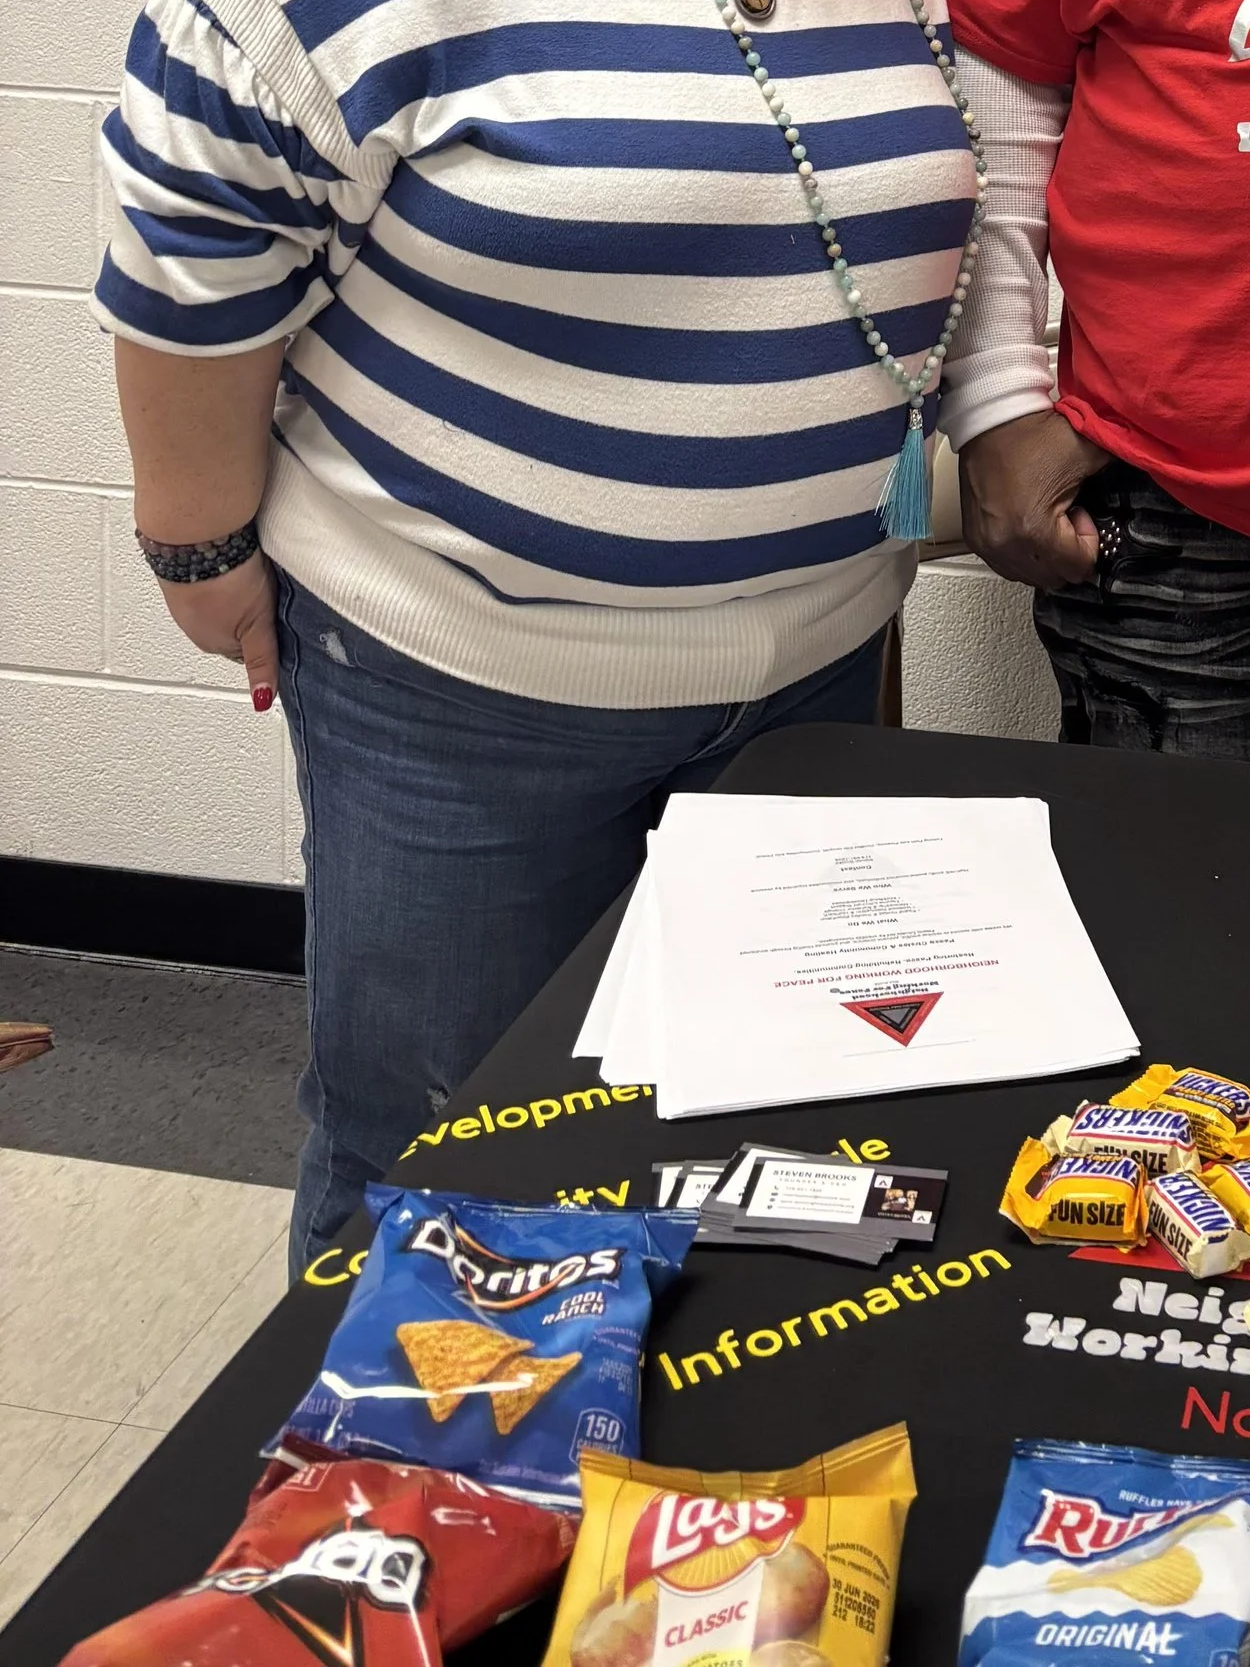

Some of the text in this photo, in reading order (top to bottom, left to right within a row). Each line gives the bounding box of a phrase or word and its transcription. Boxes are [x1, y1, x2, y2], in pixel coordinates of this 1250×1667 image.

[774, 960, 1000, 988] NEIGHBORHOOD WORKING FOR PEACE
[772, 1169, 857, 1182] STEVEN BROOKS
[1048, 1198, 1127, 1226] FUN SIZE
[1150, 1201, 1194, 1261] FUN SIZE
[409, 1218, 620, 1295] Doritos
[542, 1301, 605, 1326] RANCH
[559, 1290, 604, 1312] COOL
[658, 1248, 1012, 1391] Information
[586, 1414, 621, 1443] 150
[1119, 1489, 1164, 1507] RUFFLES
[844, 1583, 861, 1599] JUN
[665, 1600, 749, 1648] CLASSIC
[1035, 1621, 1184, 1657] ORIGINAL
